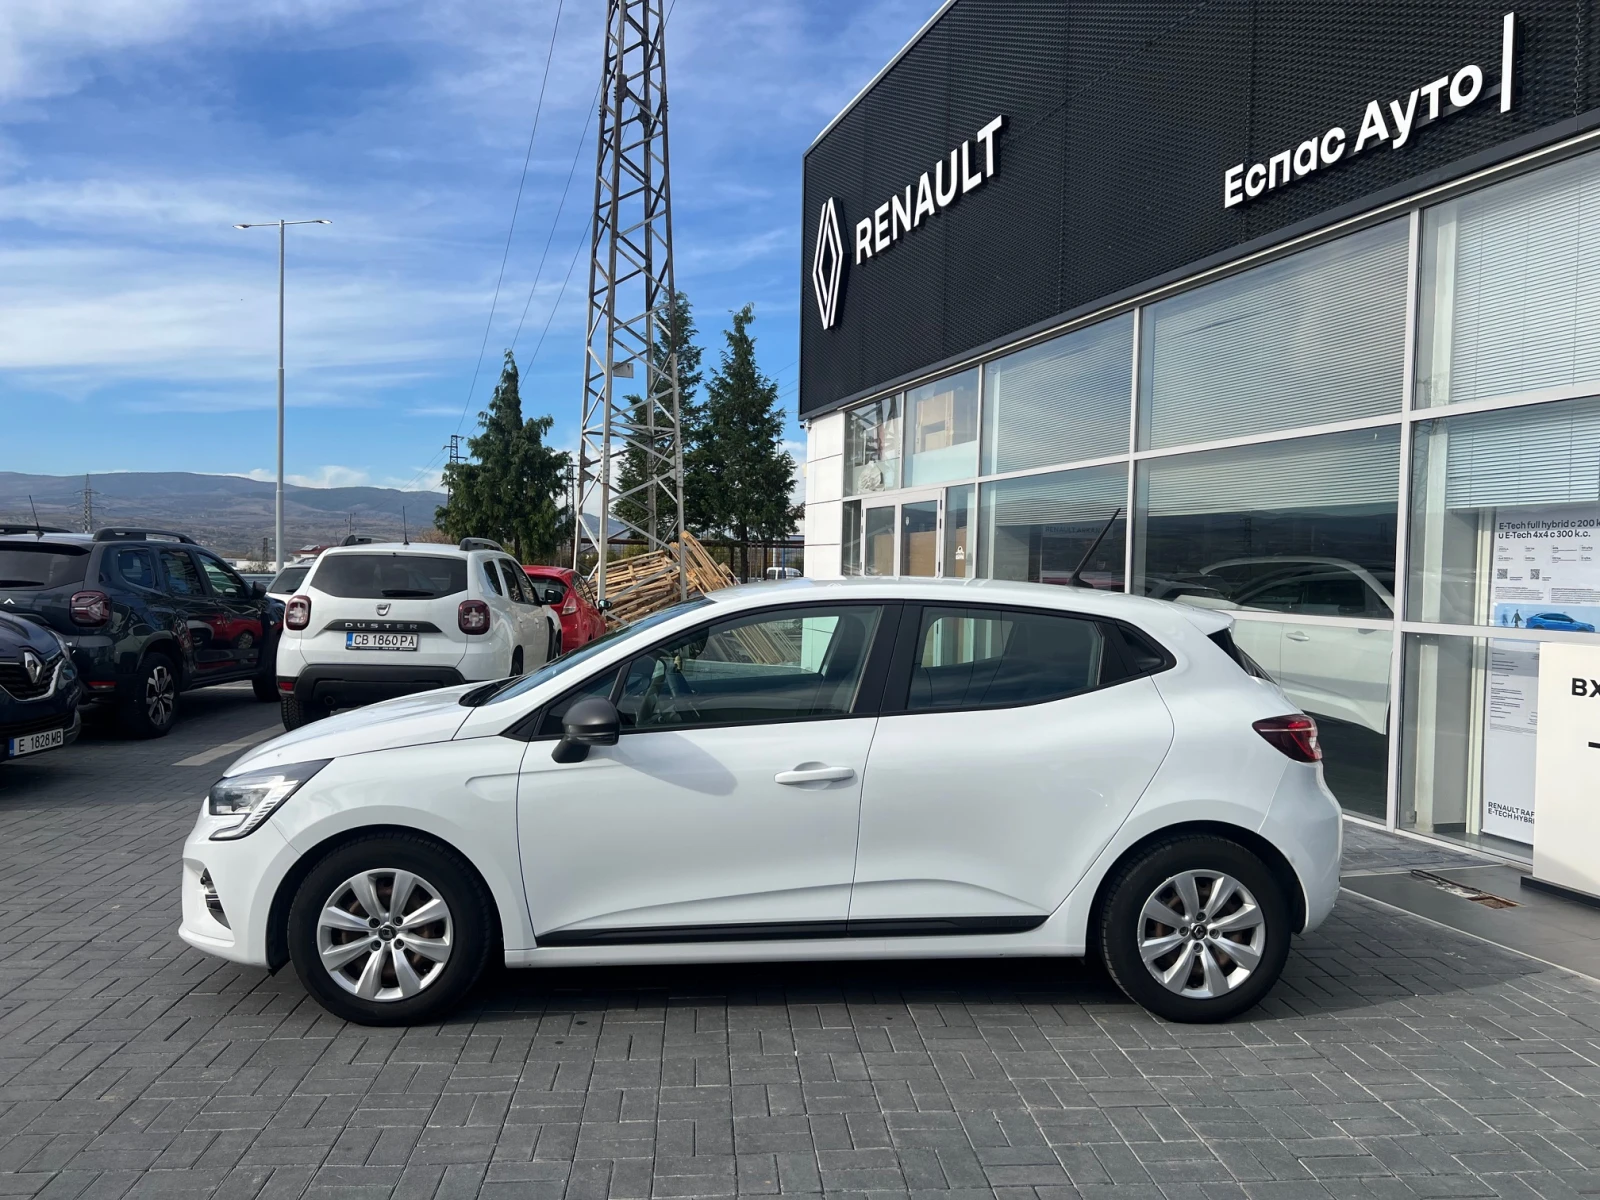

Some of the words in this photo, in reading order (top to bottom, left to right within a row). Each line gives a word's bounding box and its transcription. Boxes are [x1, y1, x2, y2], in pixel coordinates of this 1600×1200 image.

[1224, 126, 1346, 208] Еспас
[1354, 64, 1483, 153] Ауто
[856, 114, 1003, 265] RENAULT
[1499, 521, 1526, 530] E-Tech
[1527, 520, 1540, 529] full
[1541, 519, 1569, 530] hybrid
[1577, 519, 1595, 528] 200
[1505, 531, 1532, 539] E-Tech
[1556, 530, 1574, 538] 300
[345, 622, 418, 630] DUSTER
[354, 634, 369, 645] CB
[372, 634, 398, 646] 1860
[400, 635, 414, 646] PA
[18, 738, 25, 752] E
[31, 733, 50, 750] 1828
[1488, 801, 1519, 814] RENAULT
[1488, 808, 1513, 819] E-TECH
